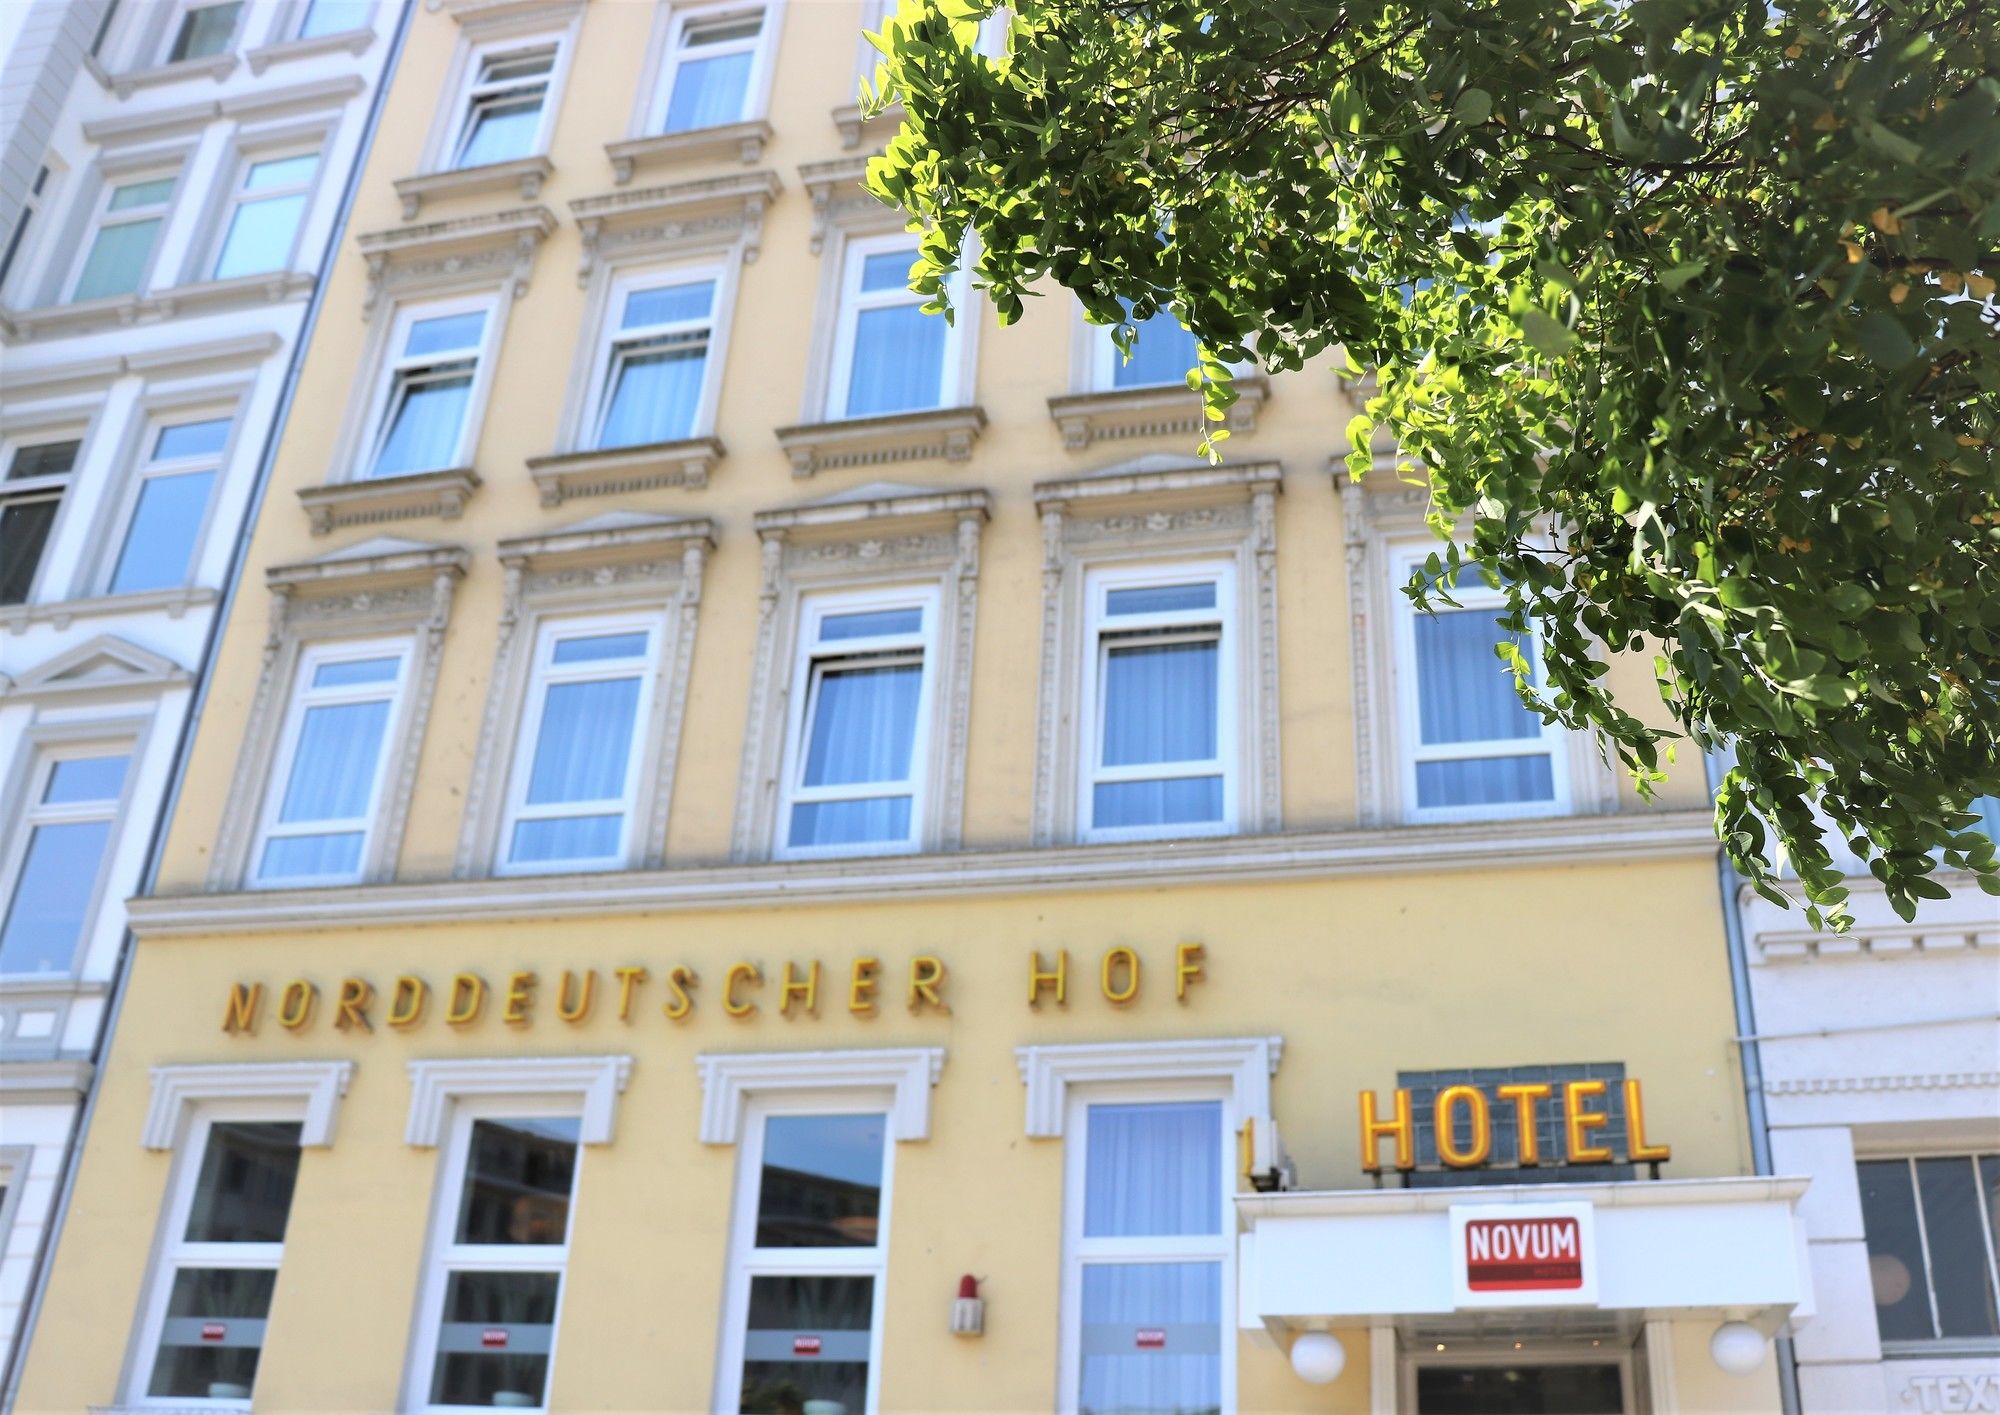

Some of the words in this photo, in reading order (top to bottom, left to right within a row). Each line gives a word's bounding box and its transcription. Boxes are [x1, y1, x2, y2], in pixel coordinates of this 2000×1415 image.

[223, 957, 948, 1034] NORDDEUTSCHER
[1028, 943, 1206, 1007] HOF
[1360, 1079, 1671, 1172] HOTEL
[1469, 1222, 1577, 1261] NOVUM
